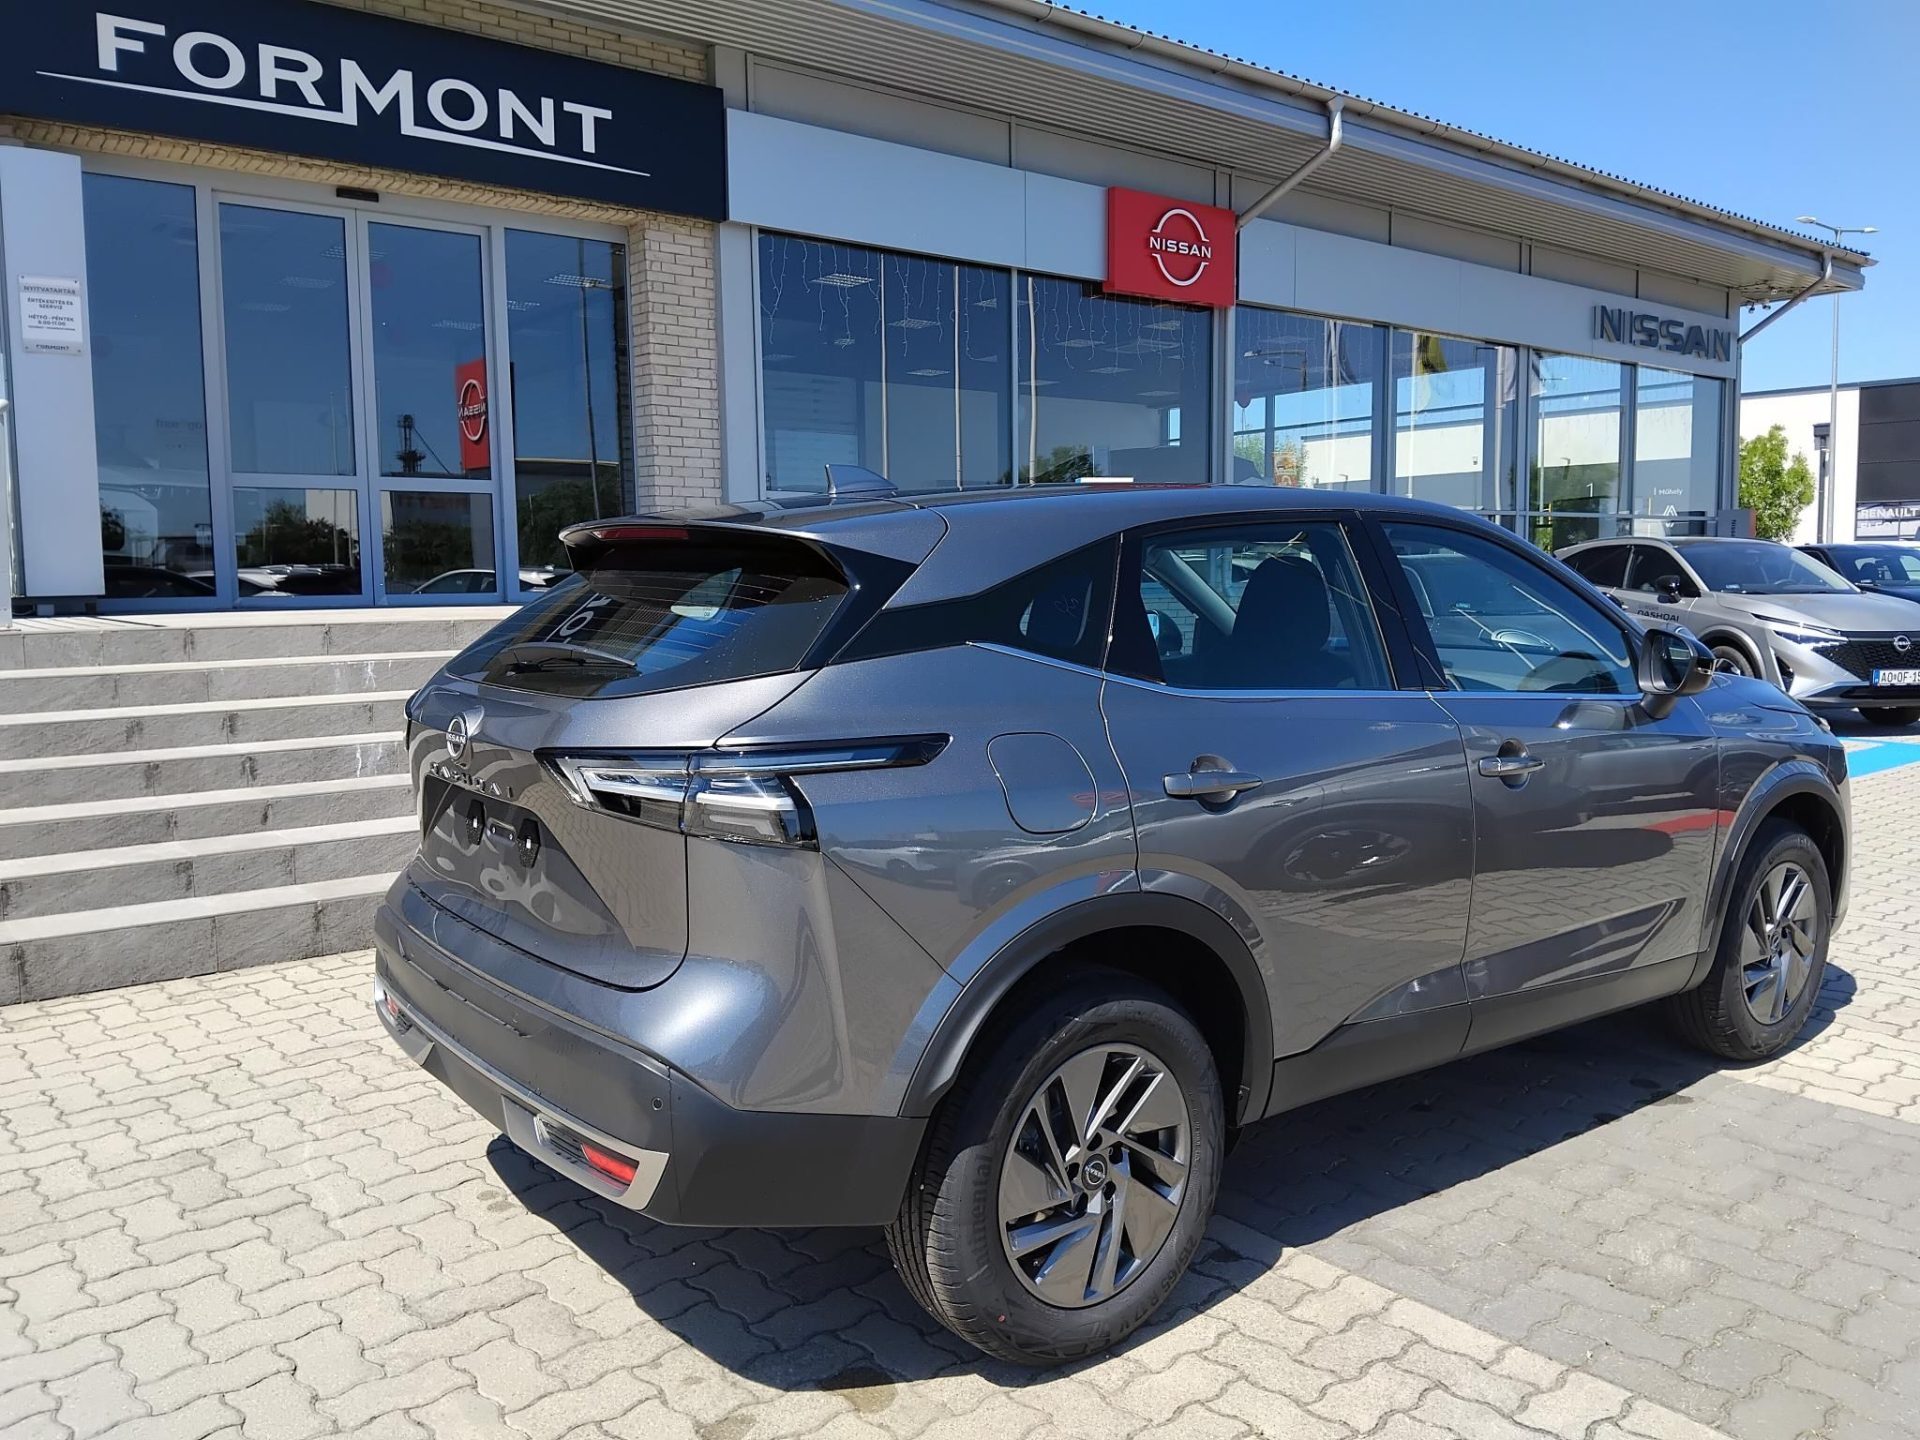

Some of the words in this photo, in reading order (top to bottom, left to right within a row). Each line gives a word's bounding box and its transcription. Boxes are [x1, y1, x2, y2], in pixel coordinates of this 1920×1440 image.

[95, 12, 613, 154] FORMONT
[1149, 236, 1212, 259] NISSAN
[1592, 304, 1731, 362] NISSAN
[1860, 507, 1919, 518] RENAULT
